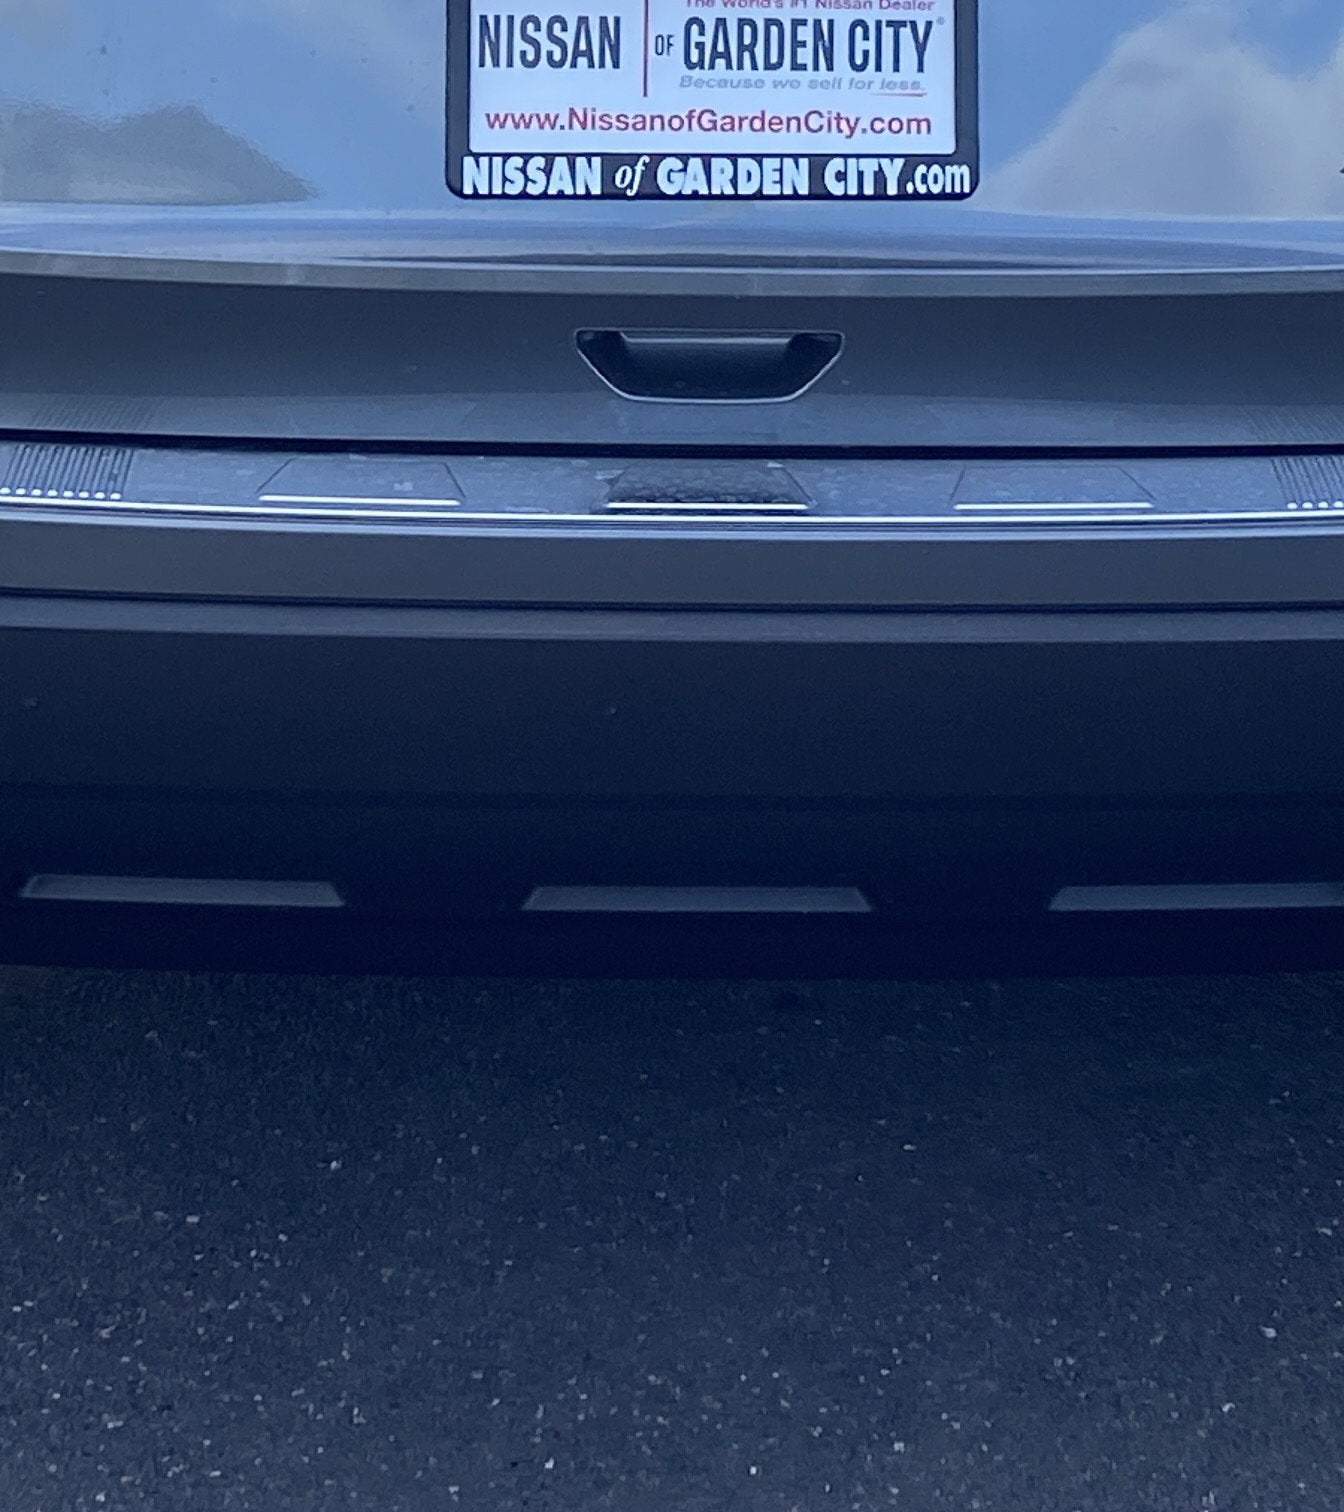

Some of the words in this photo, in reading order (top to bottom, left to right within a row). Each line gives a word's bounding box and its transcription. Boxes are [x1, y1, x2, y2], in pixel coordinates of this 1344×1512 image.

[478, 14, 621, 70] NISSAN
[654, 34, 675, 56] OF
[683, 16, 835, 72] GARDEN
[848, 18, 934, 74] CITY
[679, 75, 766, 89] Because
[772, 80, 801, 89] we
[848, 77, 873, 90] for
[485, 107, 932, 139] www.NissanofGardenCity.com
[462, 155, 603, 196] NISSAN
[613, 154, 651, 197] of
[656, 155, 810, 196] GARDEN
